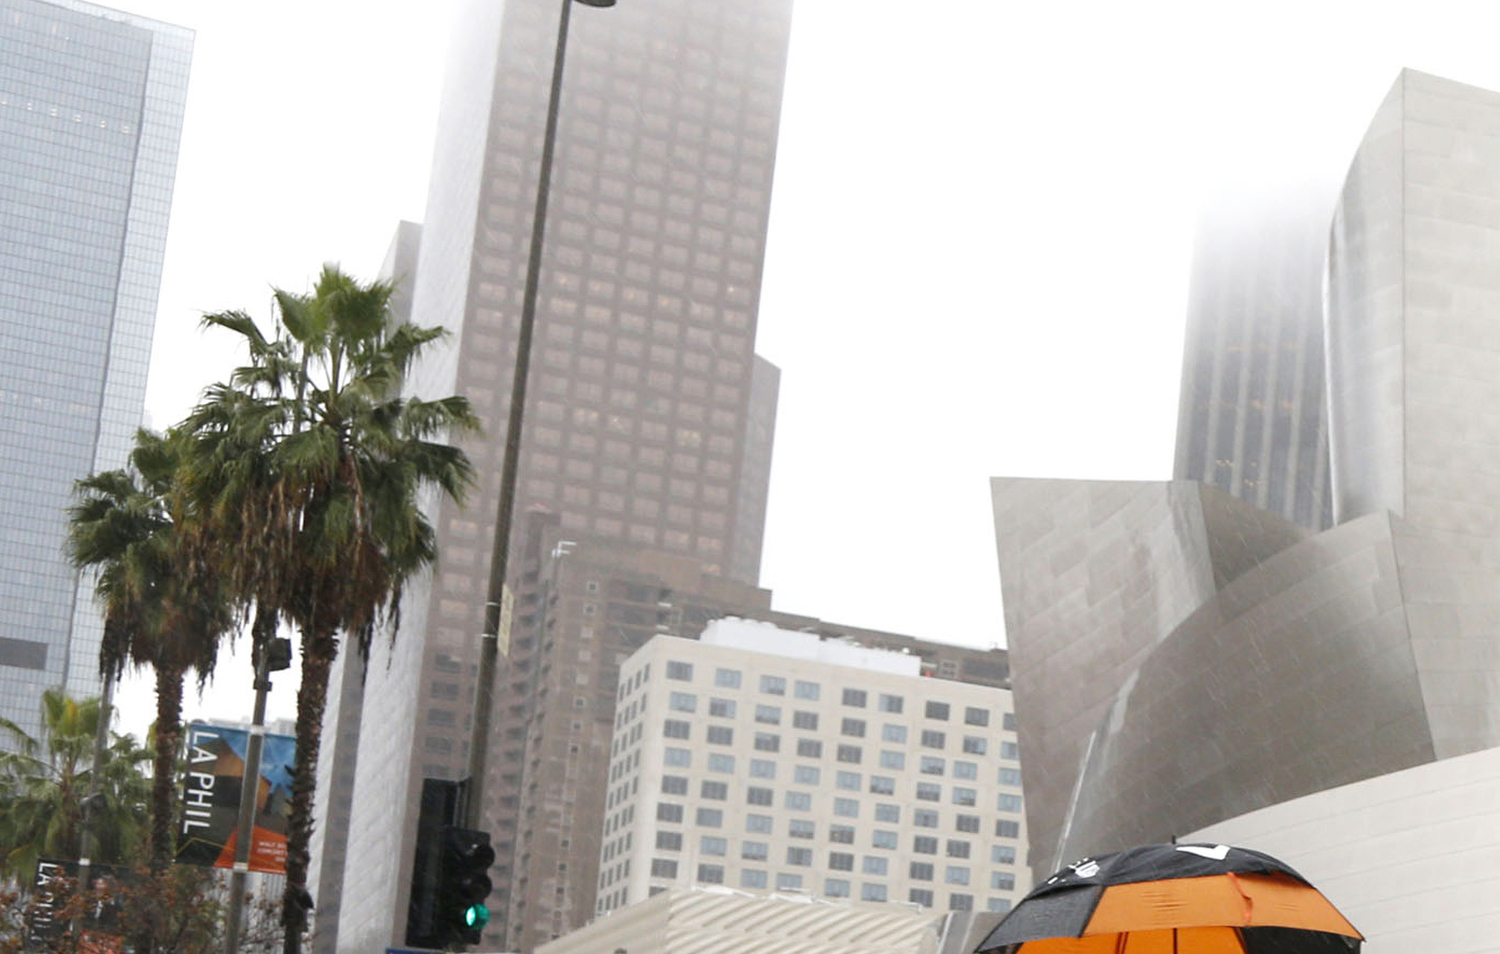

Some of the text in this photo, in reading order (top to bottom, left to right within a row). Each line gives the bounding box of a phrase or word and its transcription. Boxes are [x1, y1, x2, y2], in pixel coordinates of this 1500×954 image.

[183, 731, 220, 834] LA PHIL
[37, 863, 60, 885] LA
